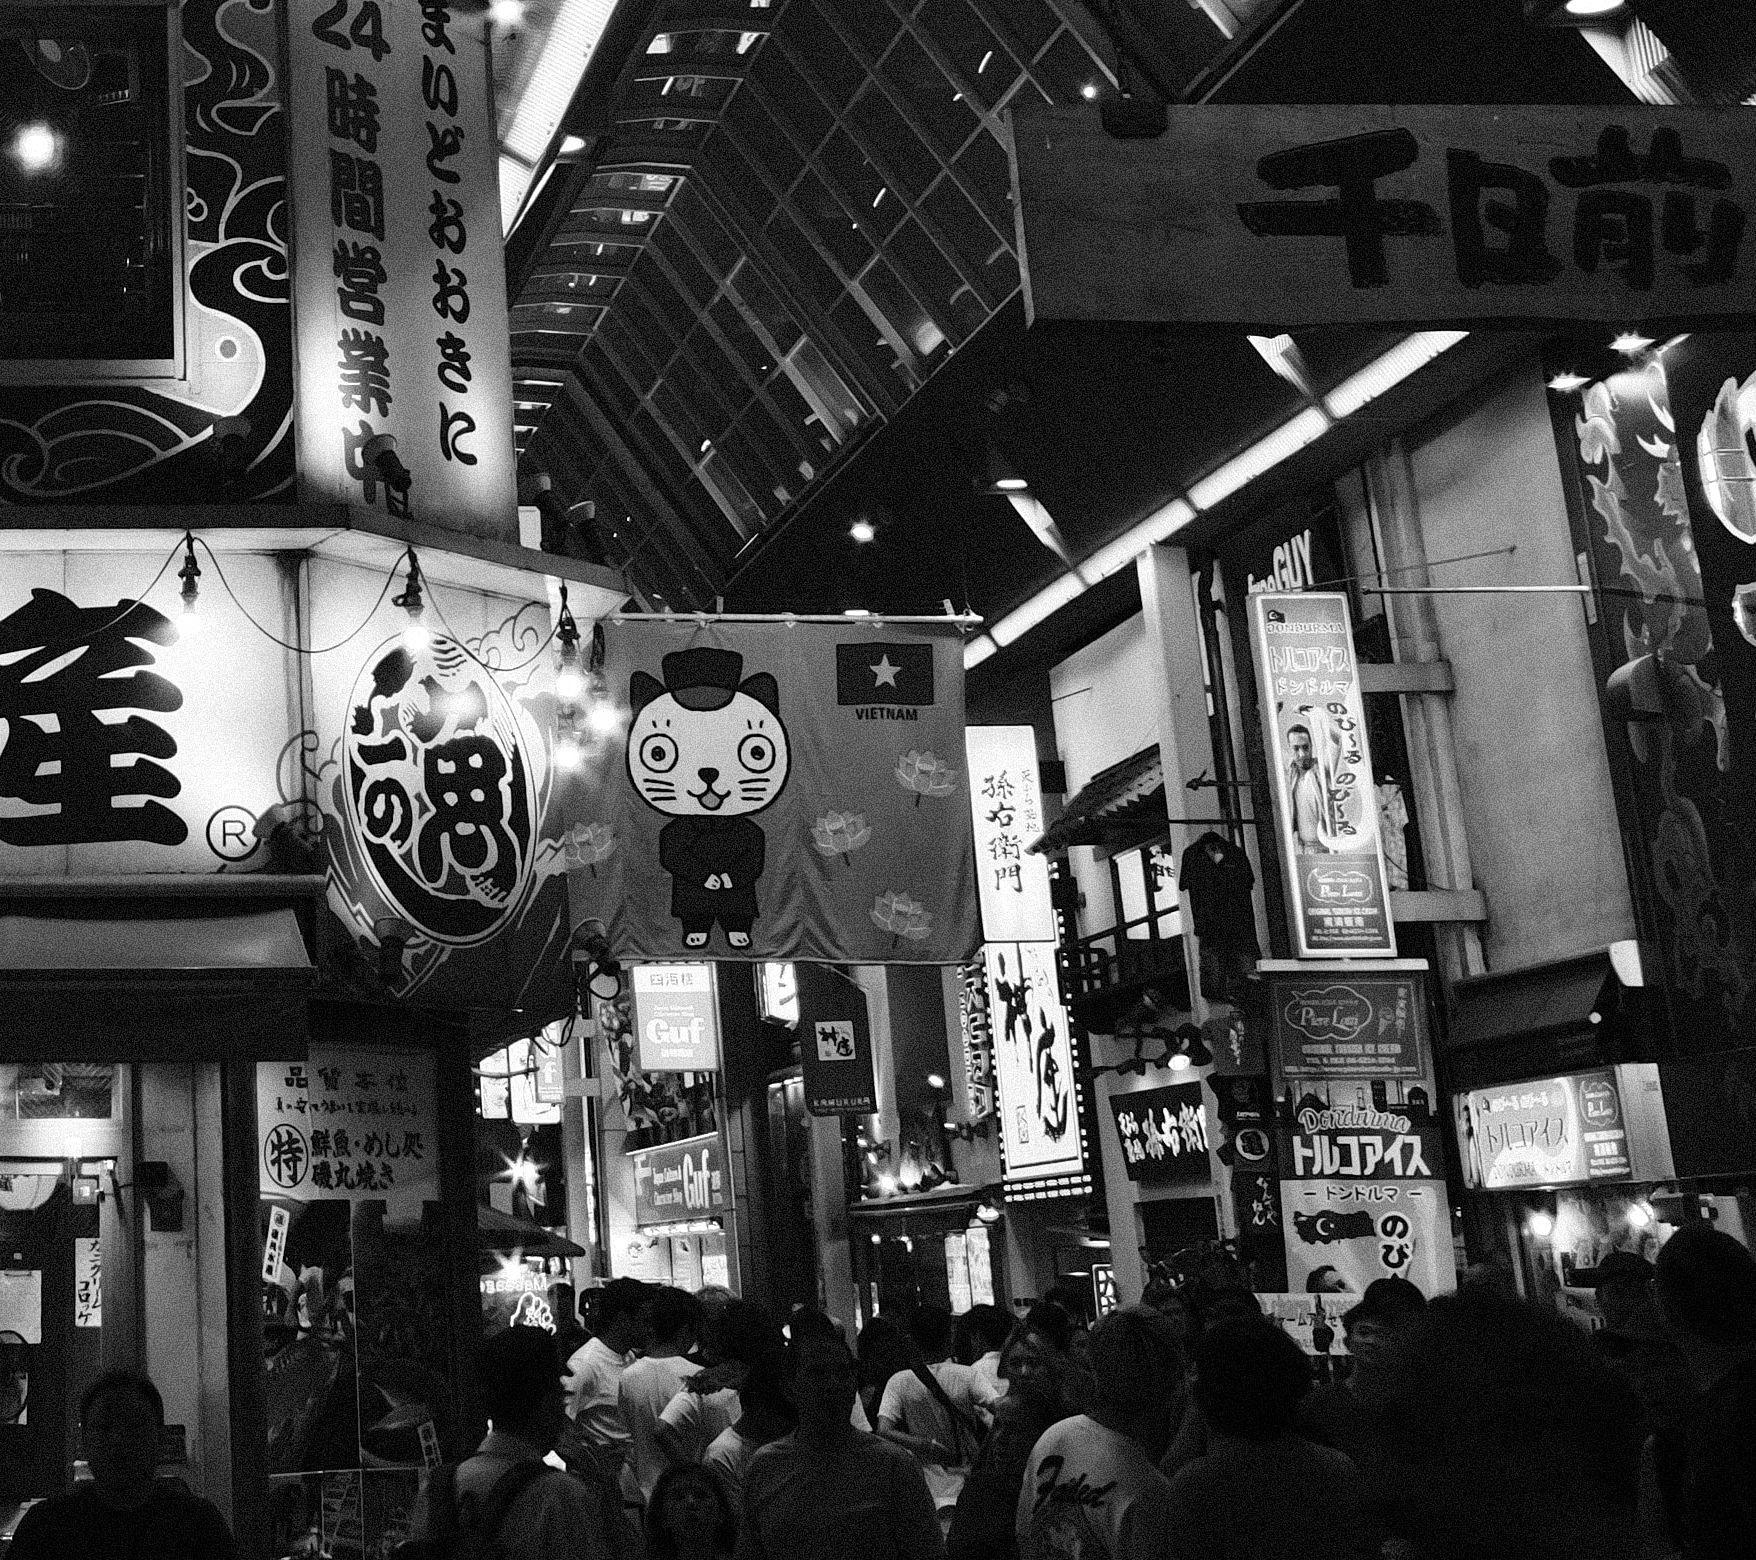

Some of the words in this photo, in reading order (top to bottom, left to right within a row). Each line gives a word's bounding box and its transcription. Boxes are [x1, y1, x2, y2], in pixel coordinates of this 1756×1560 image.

[1236, 125, 1746, 289] 千日前
[855, 707, 919, 722] VIETNAM
[981, 770, 1023, 893] 孫右衛門
[646, 1018, 705, 1045] Guf
[813, 1096, 872, 1108] KAMUKURA
[1298, 1104, 1412, 1135] Dondurma
[1292, 1134, 1433, 1177] トルコアイス
[1325, 1185, 1400, 1202] ドンドルマ
[78, 1281, 92, 1325] コロッケ
